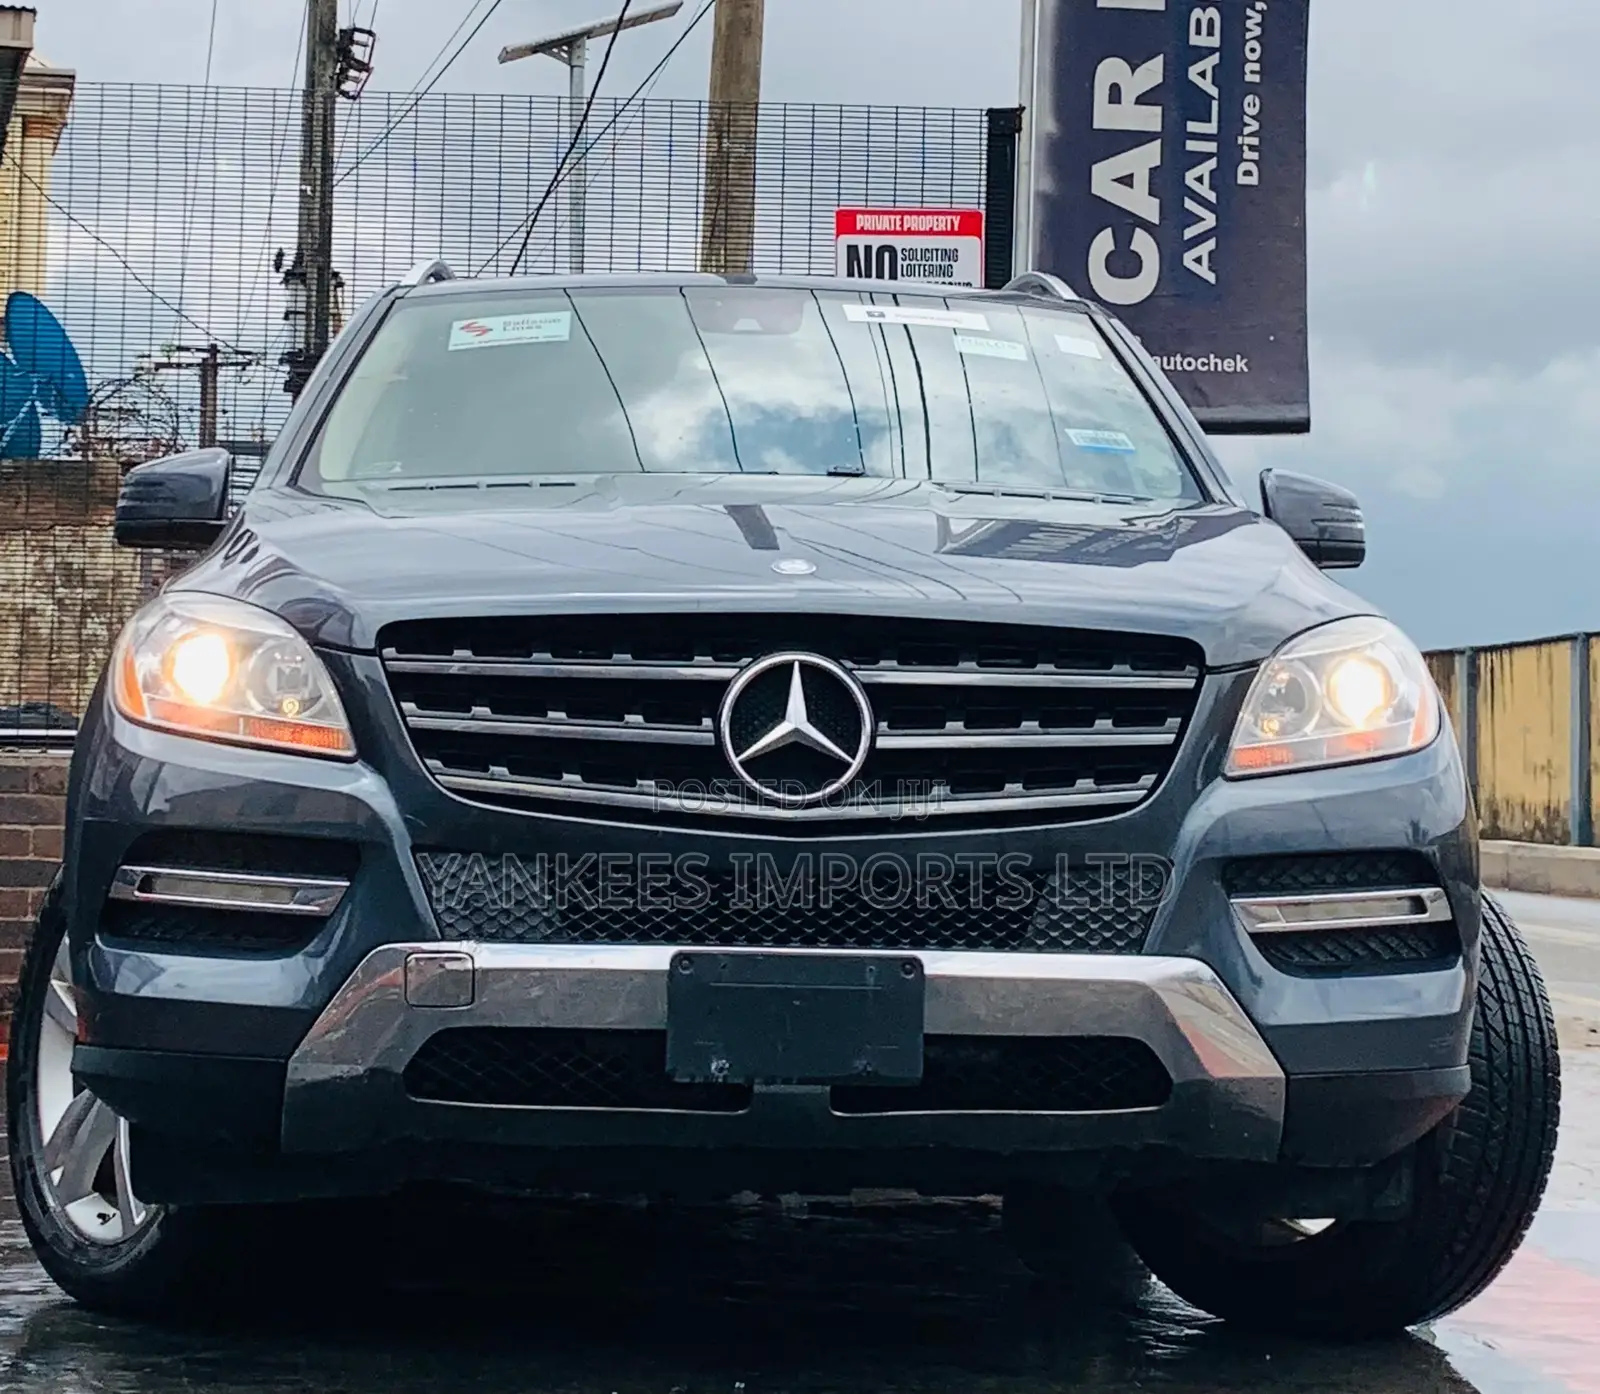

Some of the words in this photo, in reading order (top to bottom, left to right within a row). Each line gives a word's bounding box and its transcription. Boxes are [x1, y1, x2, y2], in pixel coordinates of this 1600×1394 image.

[1244, 1, 1268, 83] now,
[1183, 7, 1221, 285] AVAILAB
[1236, 94, 1261, 186] Drive
[1087, 53, 1164, 305] CAR
[856, 214, 902, 231] PRIVATE
[903, 215, 961, 232] PROPERTY
[846, 244, 898, 280] NO
[900, 247, 959, 263] SOLICITING
[900, 263, 953, 278] LOITERING
